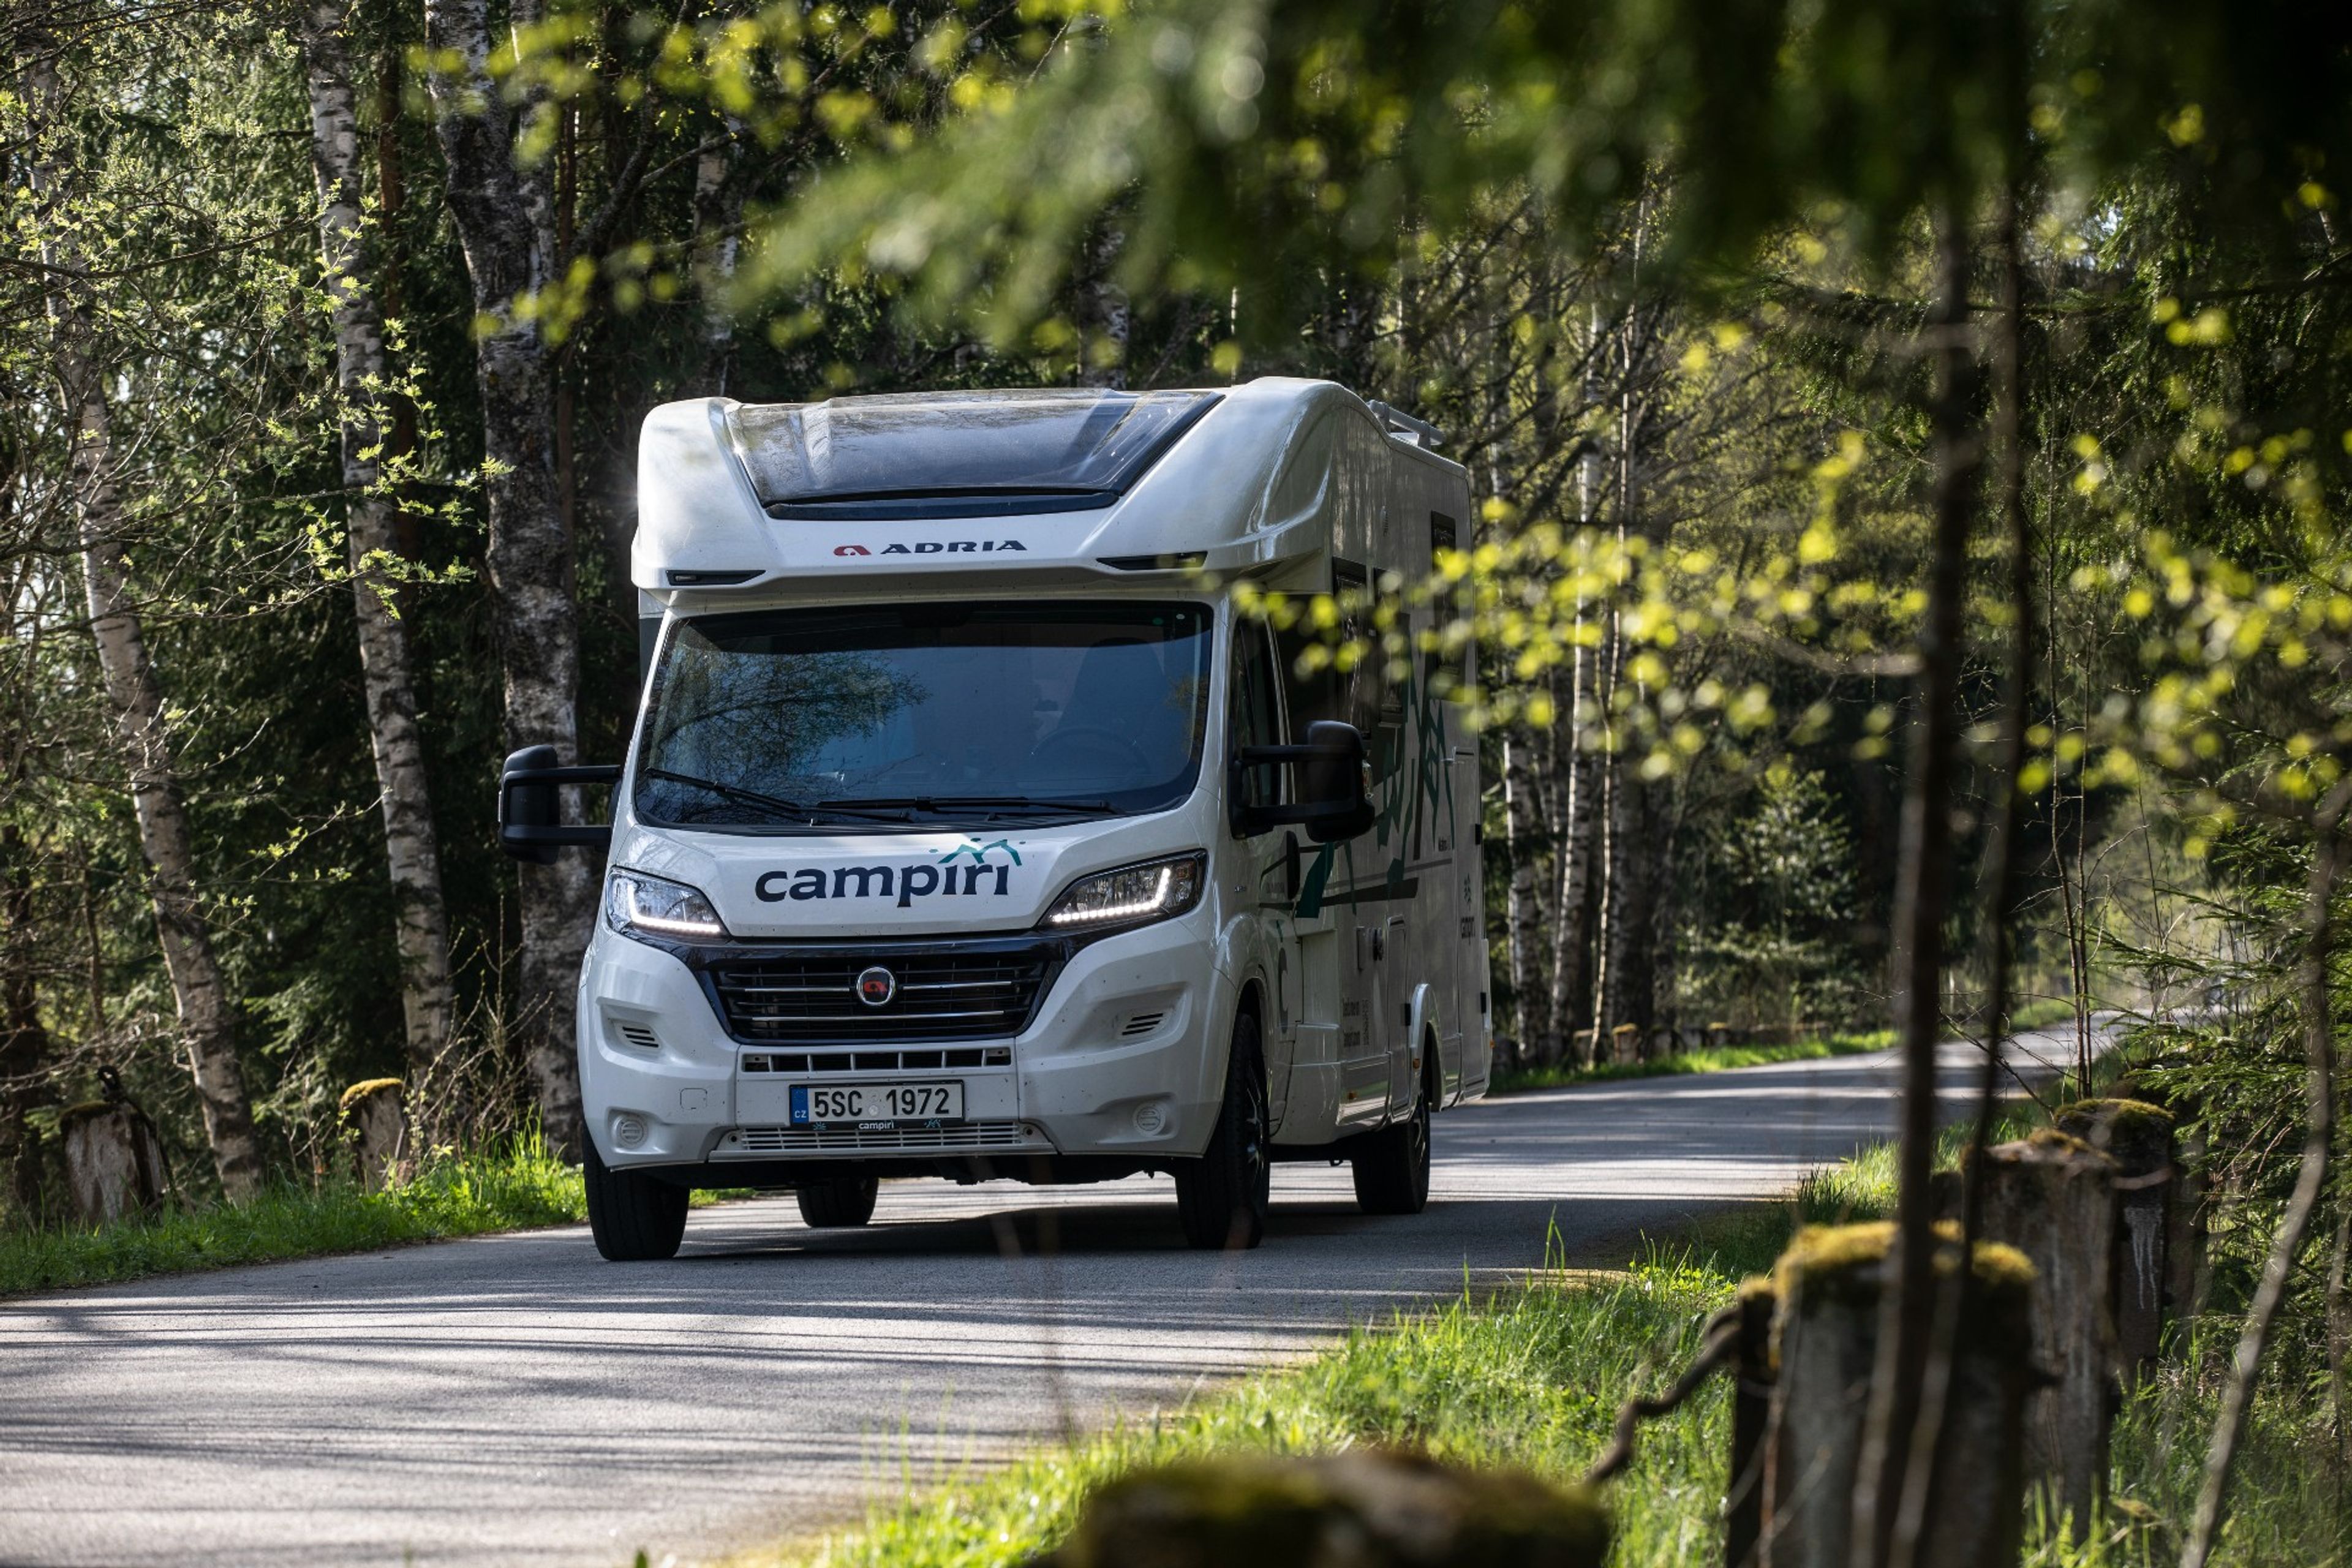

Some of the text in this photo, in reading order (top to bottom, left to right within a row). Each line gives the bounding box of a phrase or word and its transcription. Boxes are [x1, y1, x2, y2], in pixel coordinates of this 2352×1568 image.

[880, 540, 1028, 554] ADRIA
[755, 864, 1010, 908] campiri
[814, 1088, 950, 1118] 5SC 1972
[858, 1121, 894, 1131] campiri
